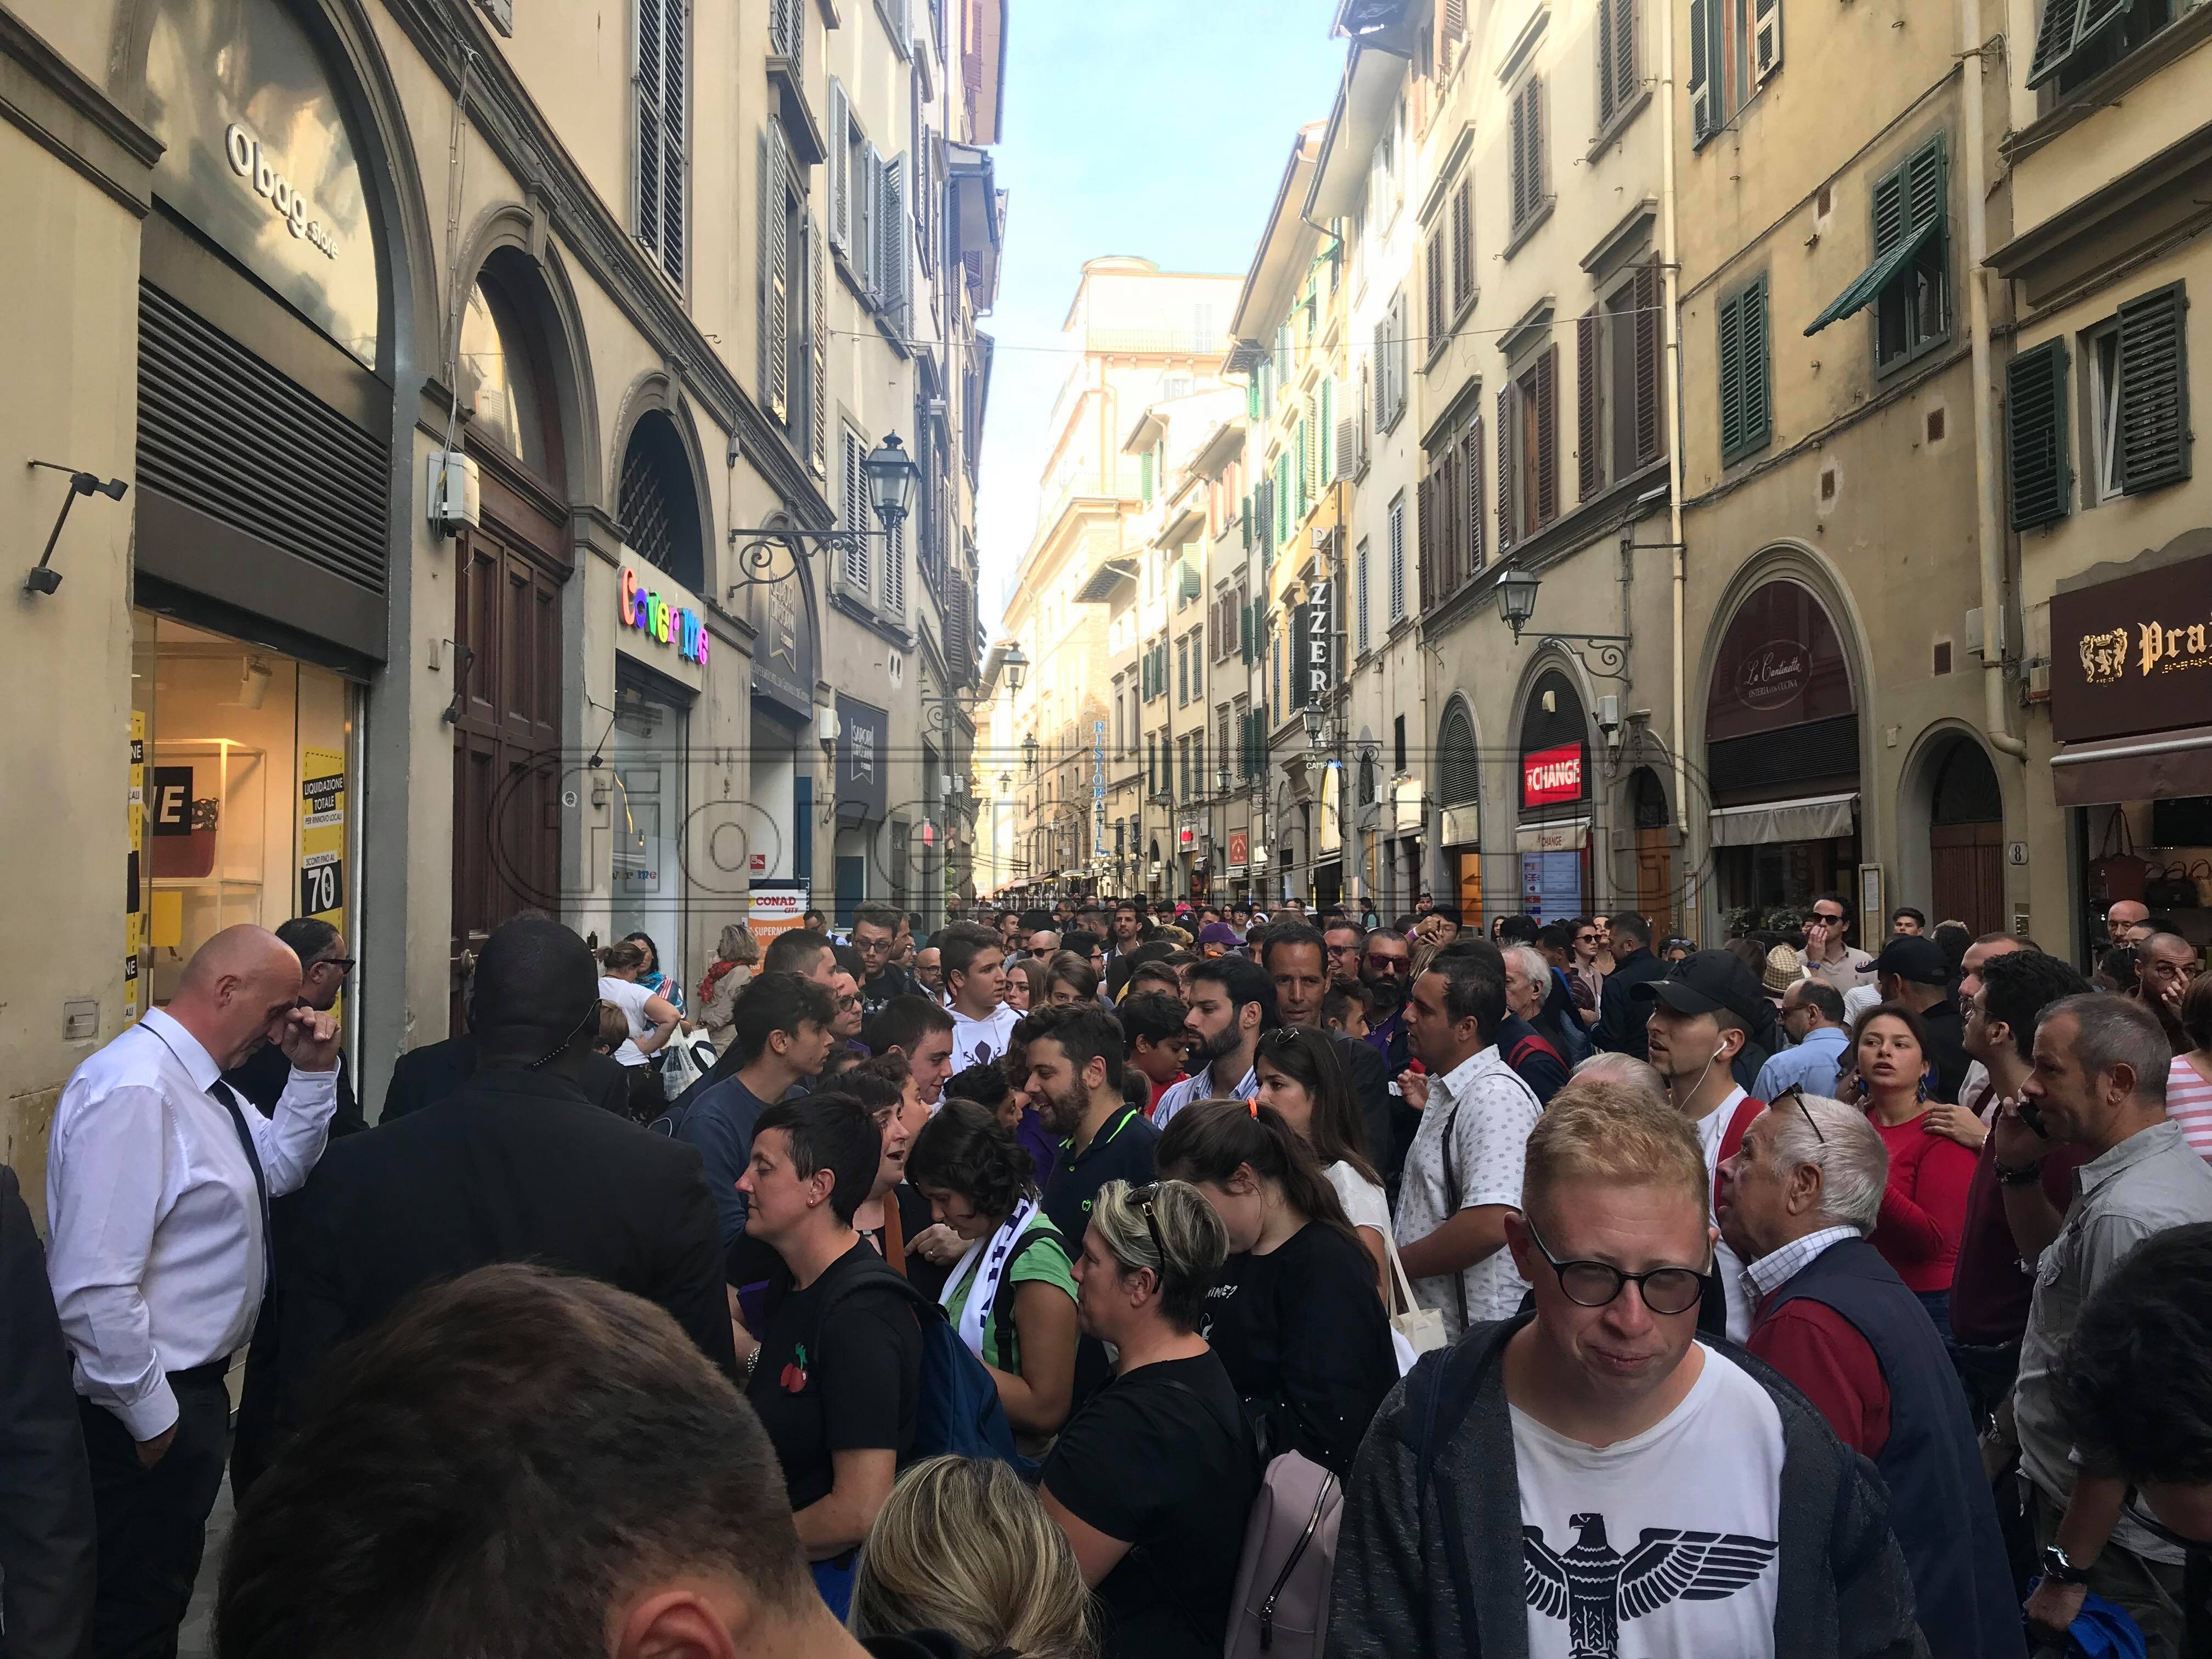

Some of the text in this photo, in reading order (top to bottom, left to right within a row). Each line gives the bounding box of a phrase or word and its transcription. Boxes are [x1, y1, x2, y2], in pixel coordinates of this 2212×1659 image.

[618, 567, 679, 644] Cover
[1307, 527, 1327, 748] PIZZERA
[2135, 613, 2212, 676] Pra
[1533, 759, 1580, 791] CHANGE
[304, 777, 343, 795] LIQUIDAZIONE
[1092, 720, 1105, 850] RISTORATE
[314, 797, 334, 811] TOTALE
[312, 815, 329, 824] RINNOVO
[1542, 836, 1562, 847] CHANGE
[306, 856, 320, 866] SCONTI
[2015, 845, 2021, 861] 8
[308, 866, 334, 912] 70
[755, 896, 796, 906] CONAD
